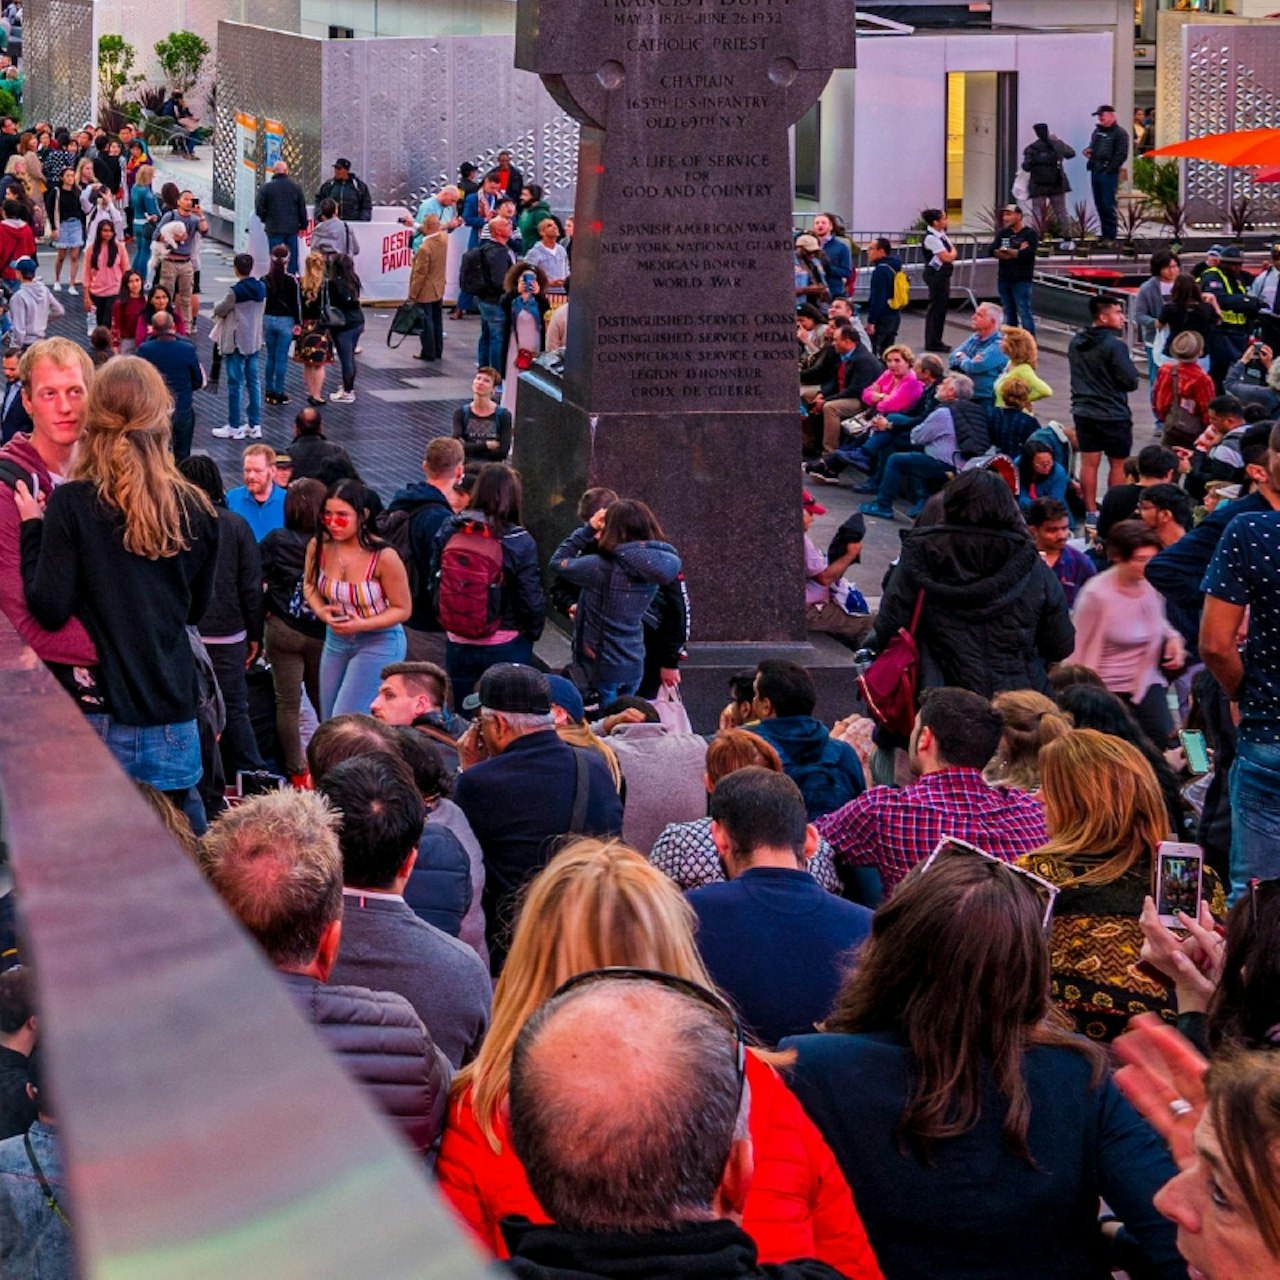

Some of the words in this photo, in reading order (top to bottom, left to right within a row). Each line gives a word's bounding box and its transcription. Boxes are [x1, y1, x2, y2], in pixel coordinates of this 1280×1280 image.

[627, 38, 704, 52] CATHOLIC
[713, 36, 768, 50] PRIEST
[661, 75, 734, 88] CHAPLAIN
[647, 117, 675, 128] OLD
[630, 156, 640, 167] A
[646, 156, 676, 167] LIFE
[682, 156, 700, 167] OF
[708, 155, 769, 167] SERVICE
[685, 171, 709, 181] FOR
[622, 186, 658, 198] GOD
[663, 185, 695, 198] AND
[701, 184, 773, 197] COUNTRY
[619, 224, 670, 235] SPANISH
[675, 223, 742, 235] AMERICAN
[747, 223, 776, 233] WAR
[603, 243, 632, 253] NEW
[635, 243, 670, 253] YORK
[677, 242, 740, 252] NATIONAL
[746, 241, 792, 251] GUARD
[639, 260, 698, 271] MEXICAN
[703, 259, 756, 270] BORDER
[653, 278, 702, 289] WORLD
[711, 277, 742, 288] WAR
[598, 315, 693, 327] DISTINGUISHED
[698, 314, 749, 325] SERVICE
[754, 313, 794, 324] CROSS
[598, 333, 693, 345] DISTINGUISHED
[698, 332, 748, 343] SERVICE
[753, 332, 794, 343] MEDAL
[597, 351, 691, 363] CONSPICUOUS
[698, 350, 748, 361] SERVICE
[753, 350, 795, 360] CROSS
[632, 369, 678, 380] LEGION
[632, 386, 675, 397] CROIX
[683, 385, 700, 397] DE
[708, 385, 762, 396] GUERRE
